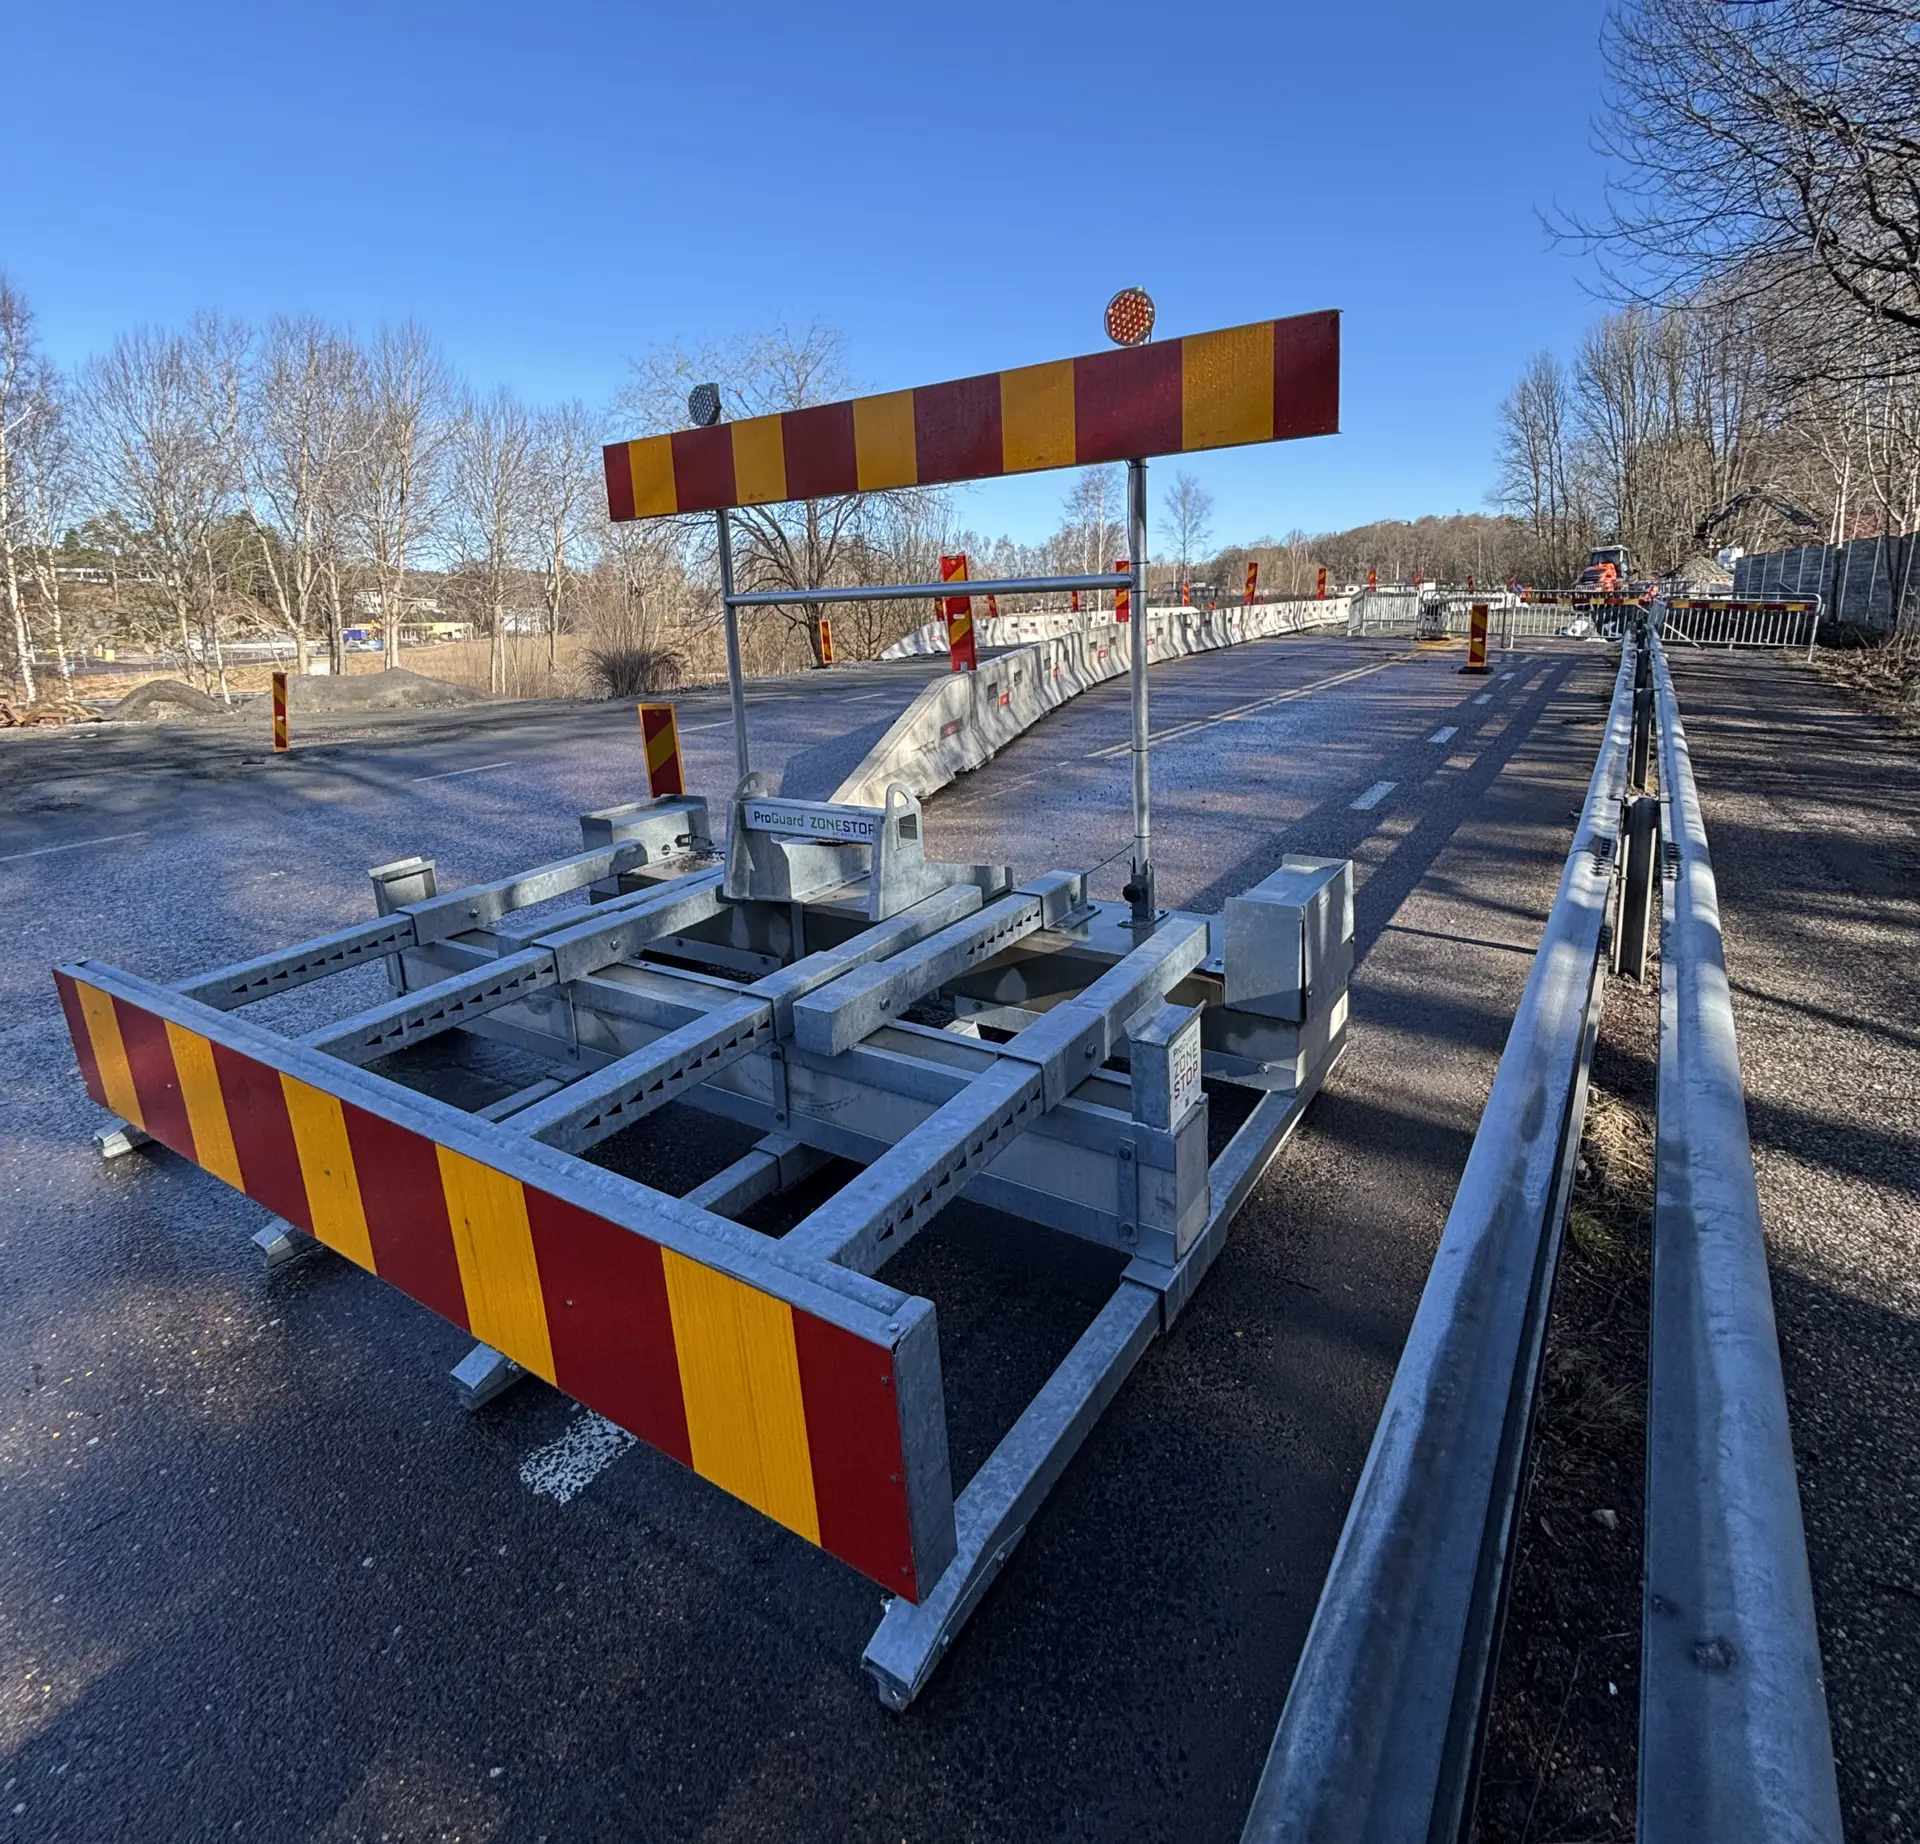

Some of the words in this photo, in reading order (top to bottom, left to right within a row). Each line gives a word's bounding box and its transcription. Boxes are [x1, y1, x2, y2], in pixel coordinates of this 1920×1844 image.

[754, 811, 804, 827] ProGuard
[1173, 1041, 1198, 1080] ZONE
[1173, 1060, 1198, 1100] STOP
